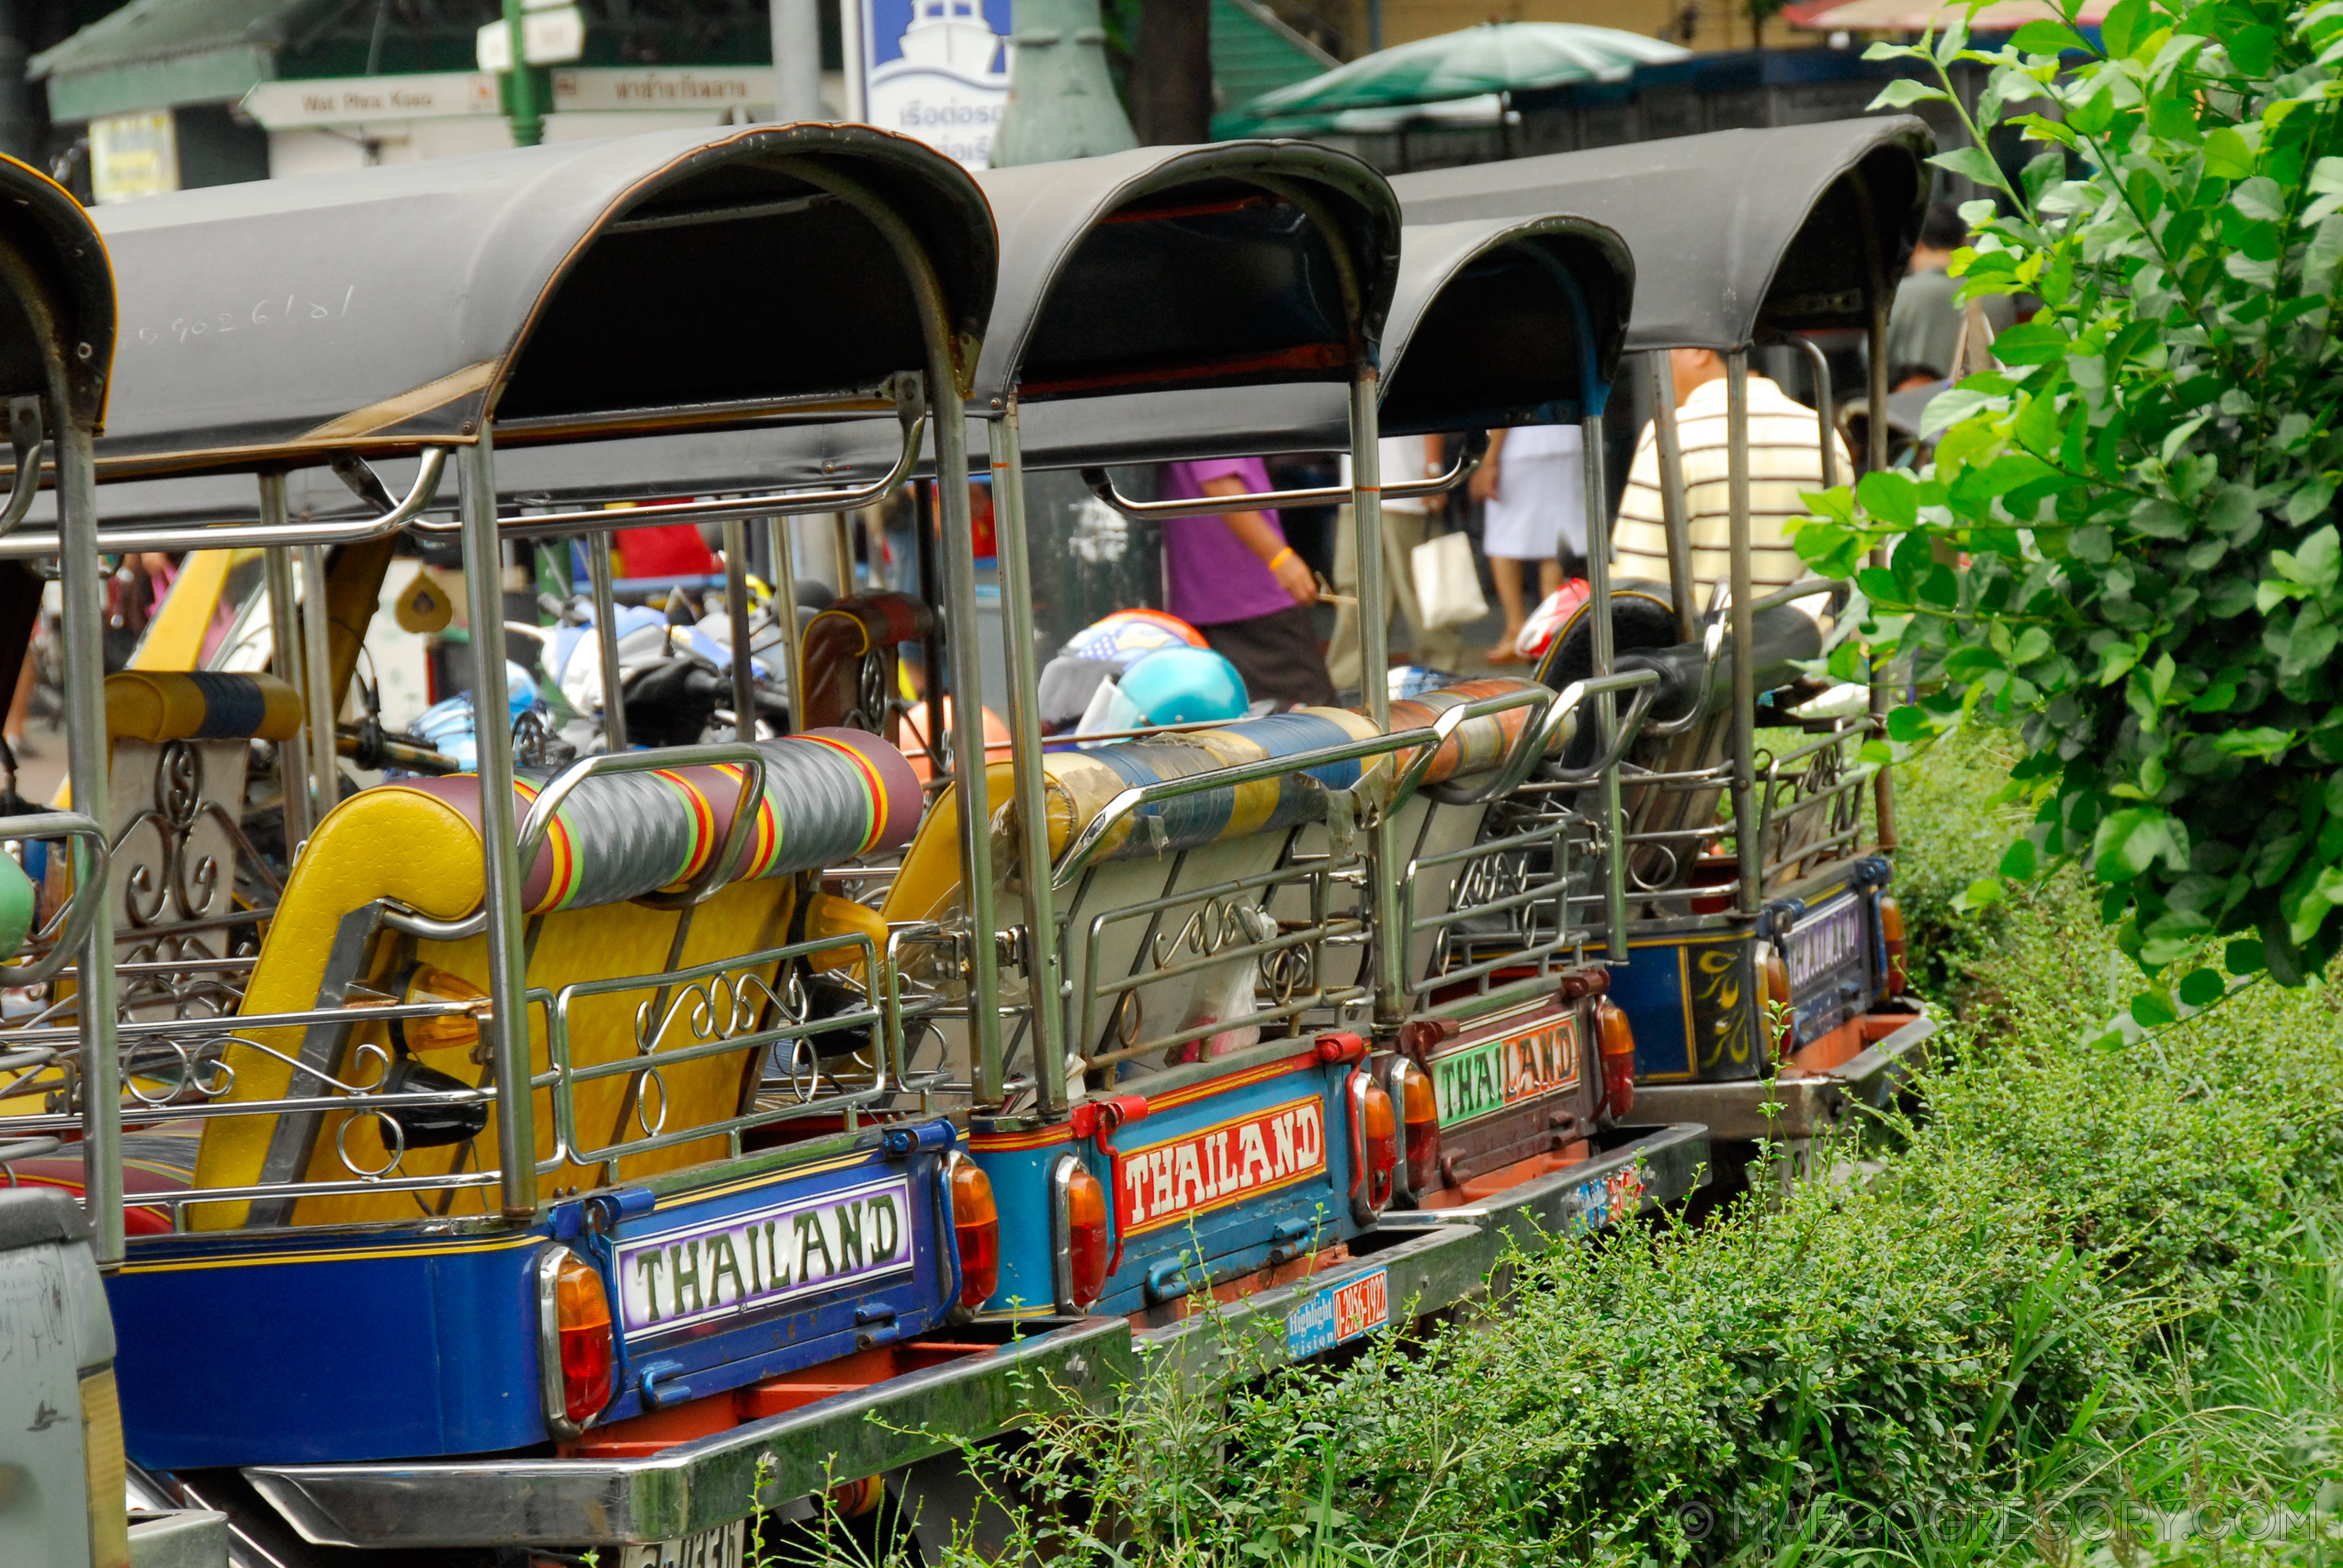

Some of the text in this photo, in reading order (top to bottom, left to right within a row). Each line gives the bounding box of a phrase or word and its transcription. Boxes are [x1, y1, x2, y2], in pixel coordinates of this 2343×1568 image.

[301, 94, 334, 112] Wat
[343, 92, 382, 110] Phra
[1441, 1025, 1573, 1120] THAILAND
[1126, 1104, 1320, 1224] THAILAND
[636, 1193, 898, 1323] THAILAND
[1289, 1297, 1332, 1337] Highlight
[1335, 1274, 1386, 1337] 0-2956-1922
